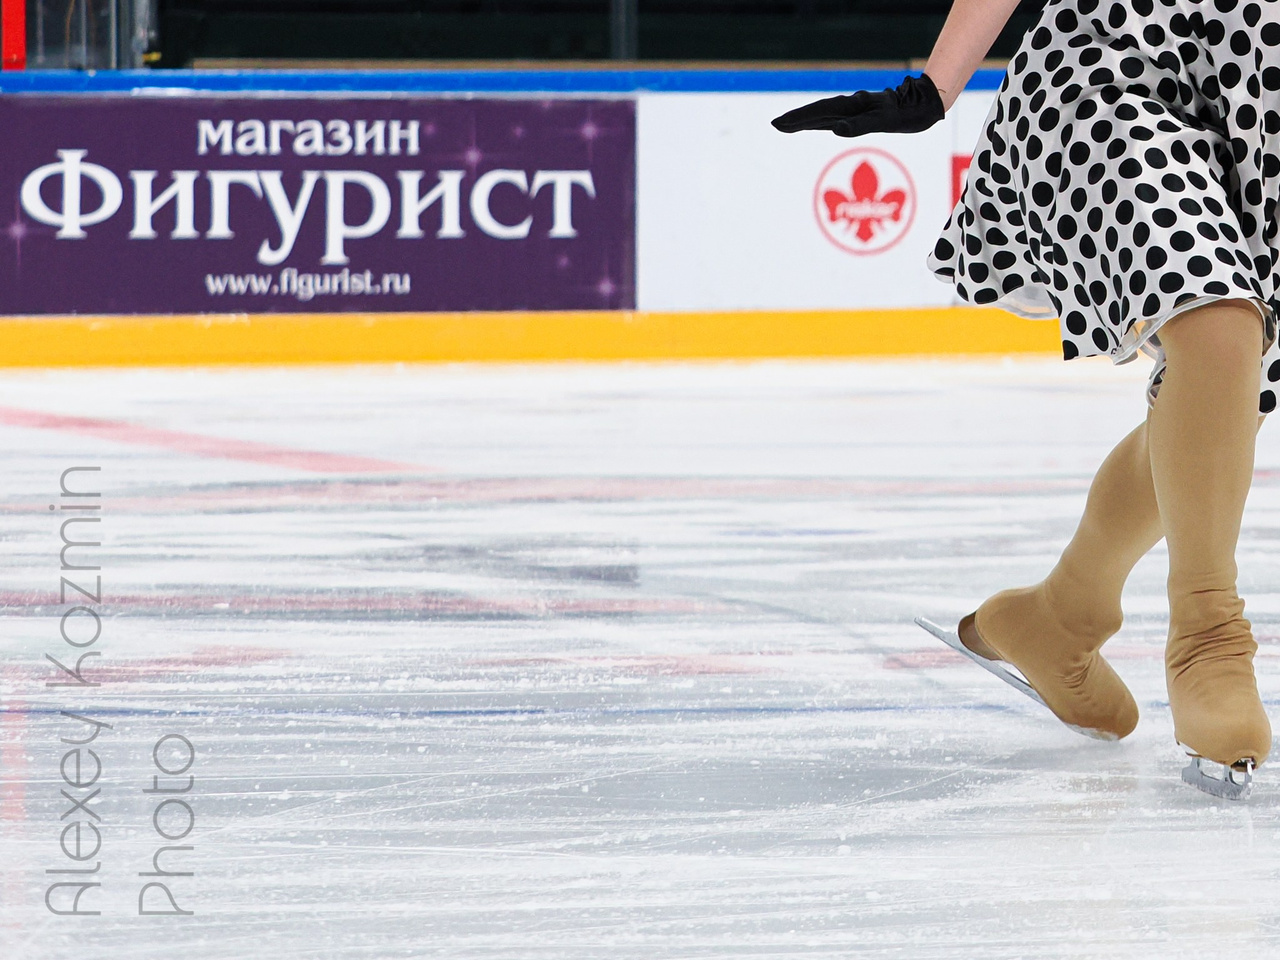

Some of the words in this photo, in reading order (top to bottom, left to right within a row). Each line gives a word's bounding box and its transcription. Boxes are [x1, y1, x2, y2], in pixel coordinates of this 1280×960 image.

[197, 119, 421, 157] магазин
[20, 148, 596, 266] Фигурист
[205, 267, 411, 302] www.figurist.ru
